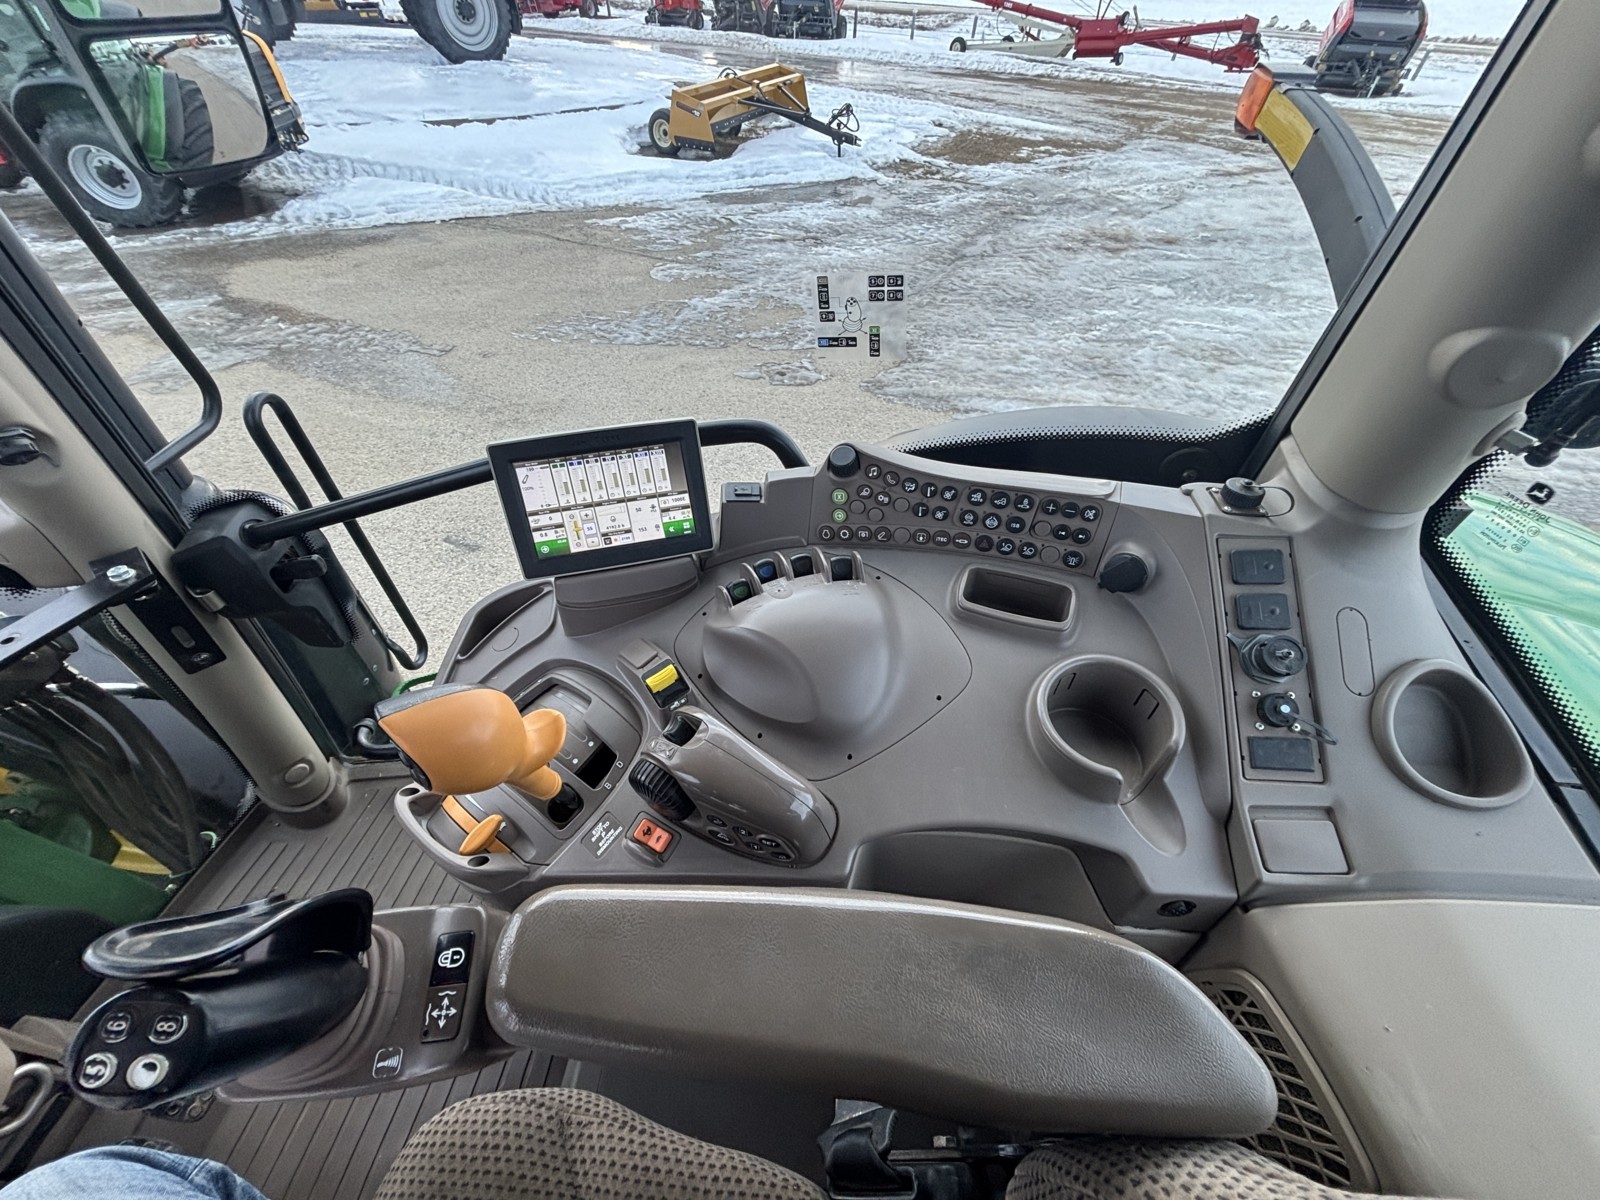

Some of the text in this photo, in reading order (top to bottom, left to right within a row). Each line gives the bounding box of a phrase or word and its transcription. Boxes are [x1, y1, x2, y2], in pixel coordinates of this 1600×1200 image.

[616, 760, 624, 769] D
[604, 782, 612, 790] B
[596, 825, 623, 856] DISMOUNTING
[599, 828, 615, 848] BEFORE
[156, 1021, 177, 1032] 8
